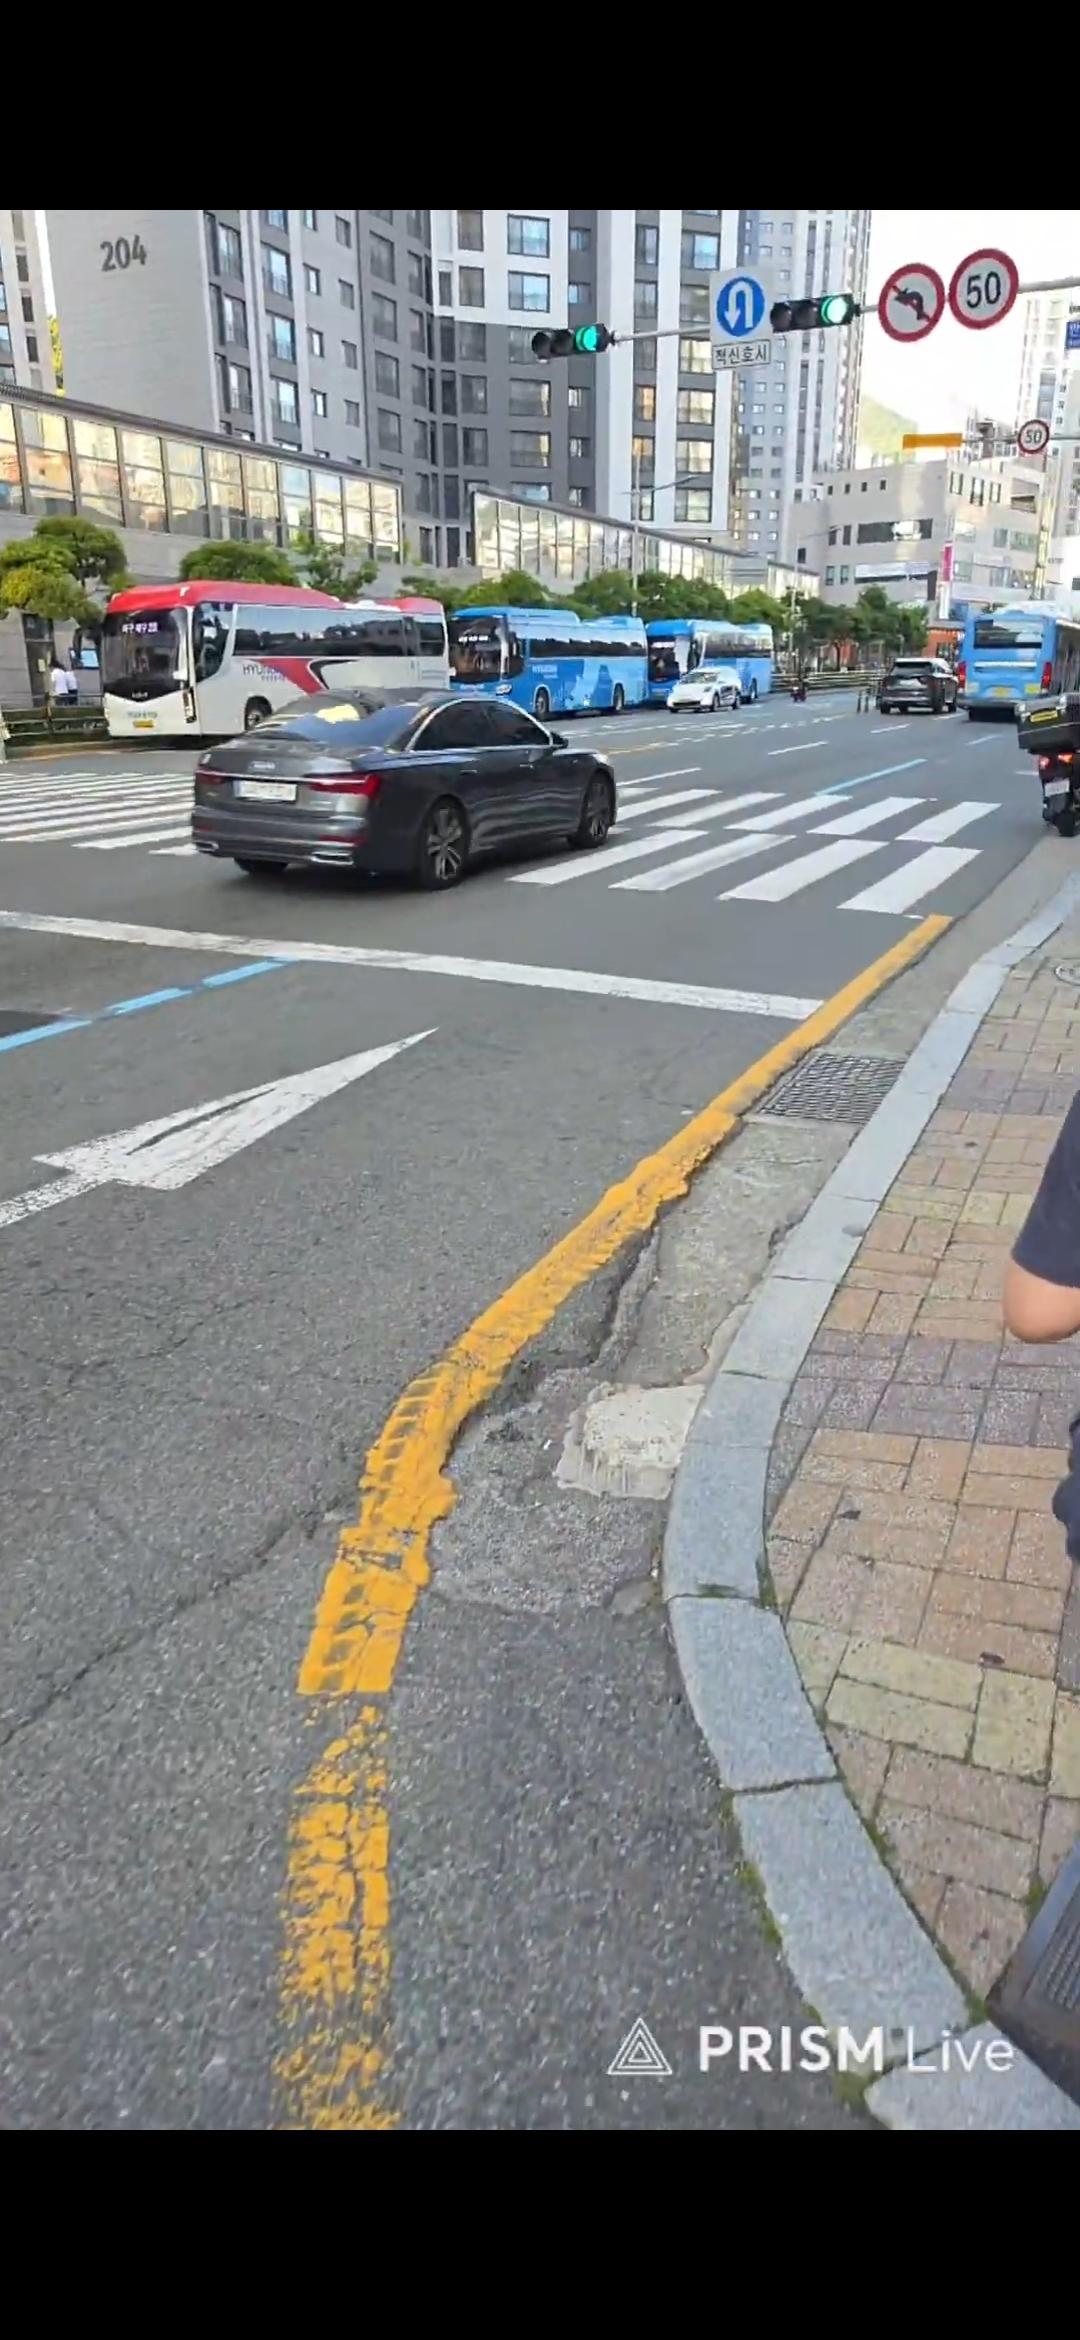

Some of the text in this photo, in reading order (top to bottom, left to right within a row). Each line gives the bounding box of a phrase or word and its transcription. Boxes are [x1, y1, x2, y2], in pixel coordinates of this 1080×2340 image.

[100, 234, 147, 271] 204
[967, 271, 1001, 308] 50
[715, 344, 767, 365] 적신호시
[1024, 429, 1042, 444] 50
